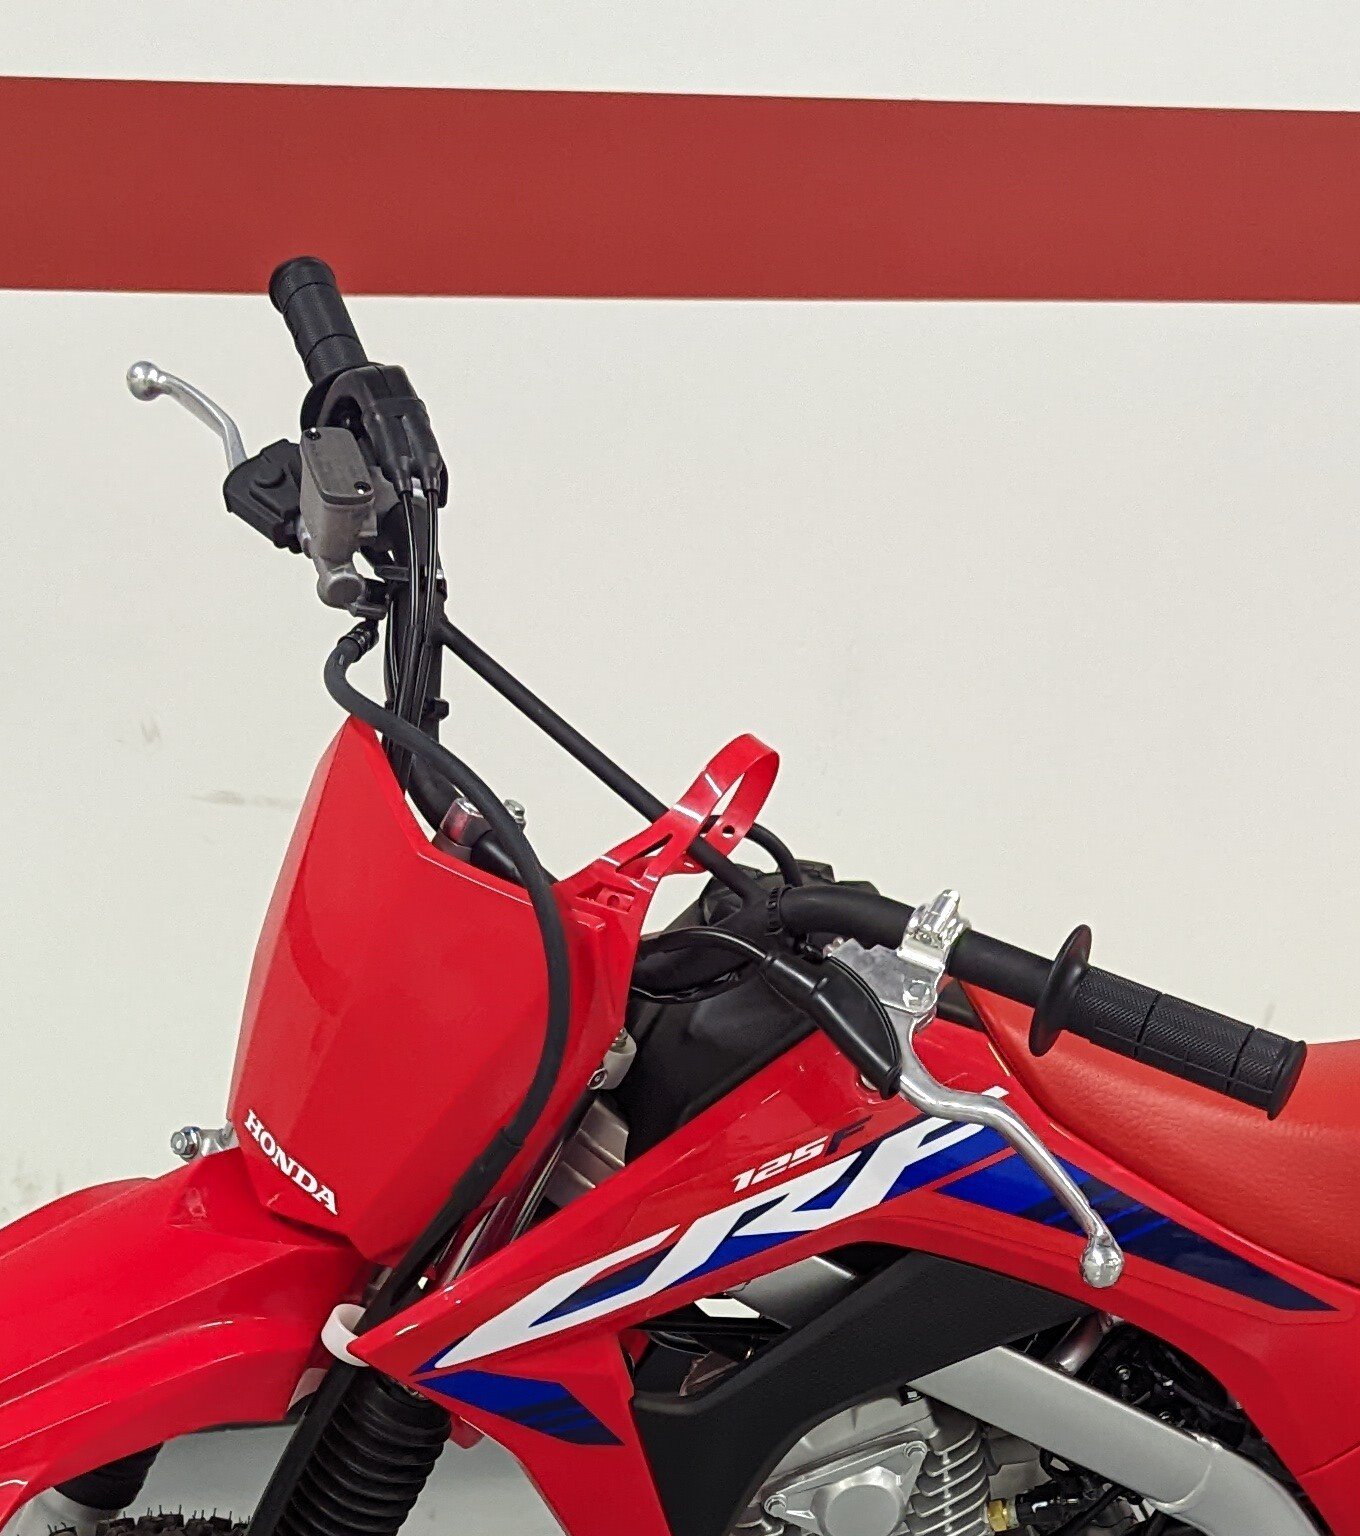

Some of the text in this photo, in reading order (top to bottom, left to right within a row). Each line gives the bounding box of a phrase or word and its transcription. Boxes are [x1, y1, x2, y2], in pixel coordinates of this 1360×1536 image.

[243, 1108, 339, 1216] HONDA
[731, 1114, 874, 1194] 125F
[434, 1085, 1010, 1369] CRF
